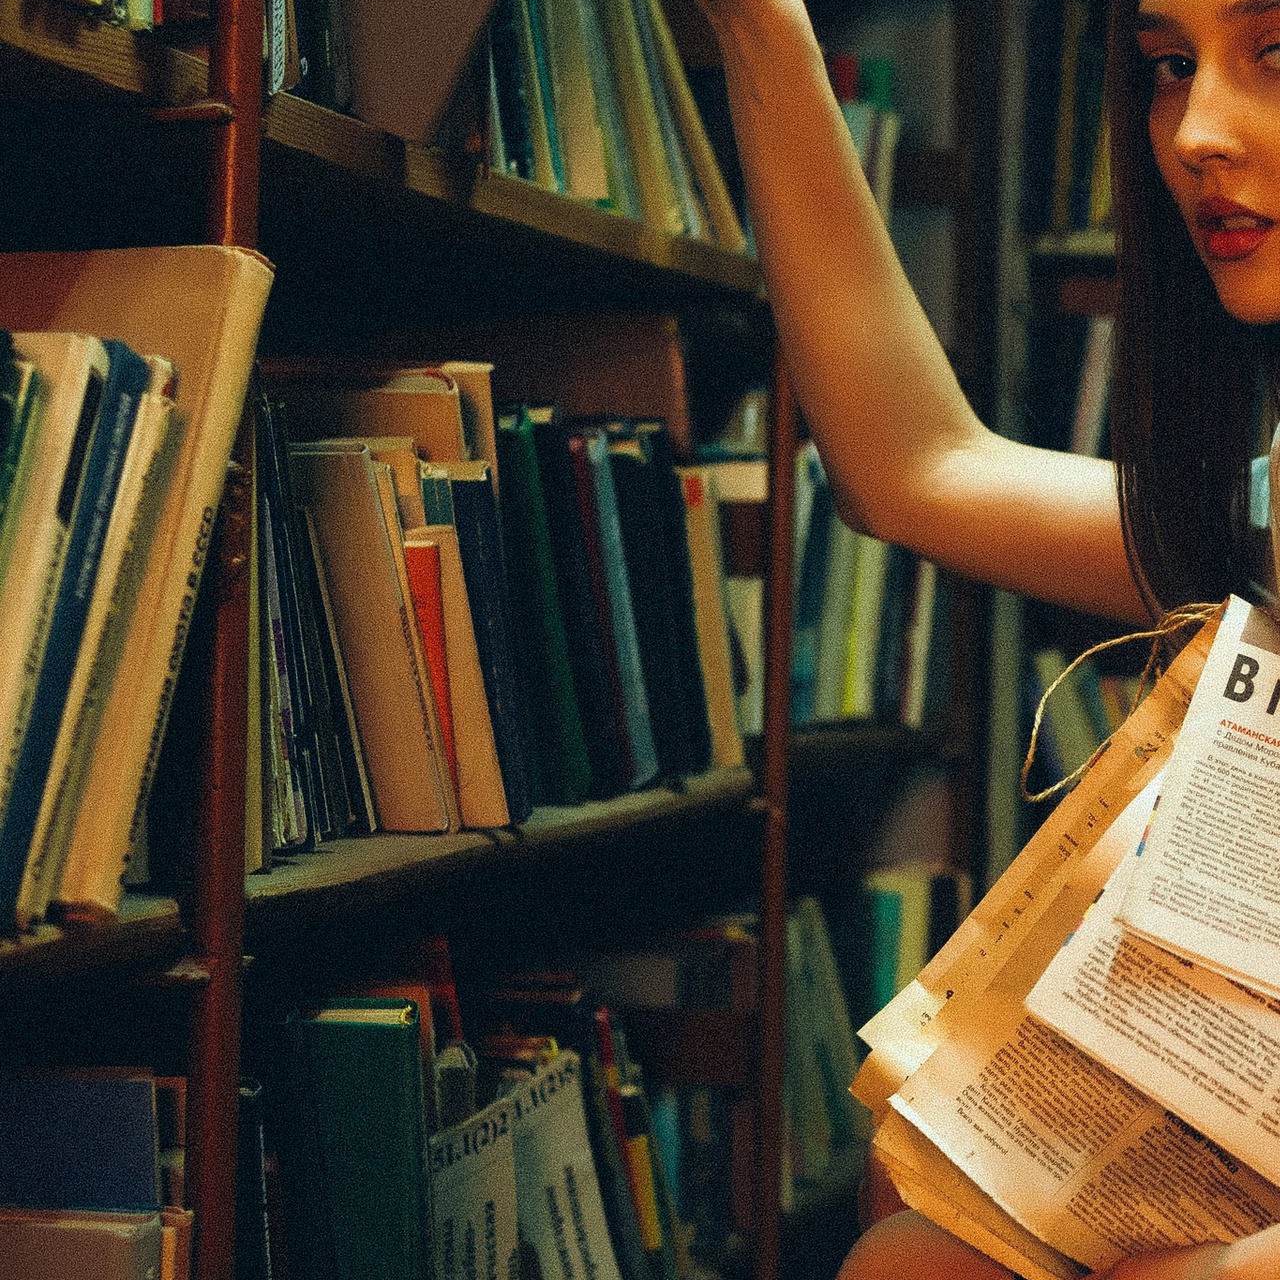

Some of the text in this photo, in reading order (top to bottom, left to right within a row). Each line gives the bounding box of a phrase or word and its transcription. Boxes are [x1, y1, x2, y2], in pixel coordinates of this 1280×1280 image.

[166, 594, 193, 671] ОХОТА
[190, 504, 215, 568] СССР
[1223, 652, 1260, 704] В
[1198, 1138, 1244, 1174] успеха
